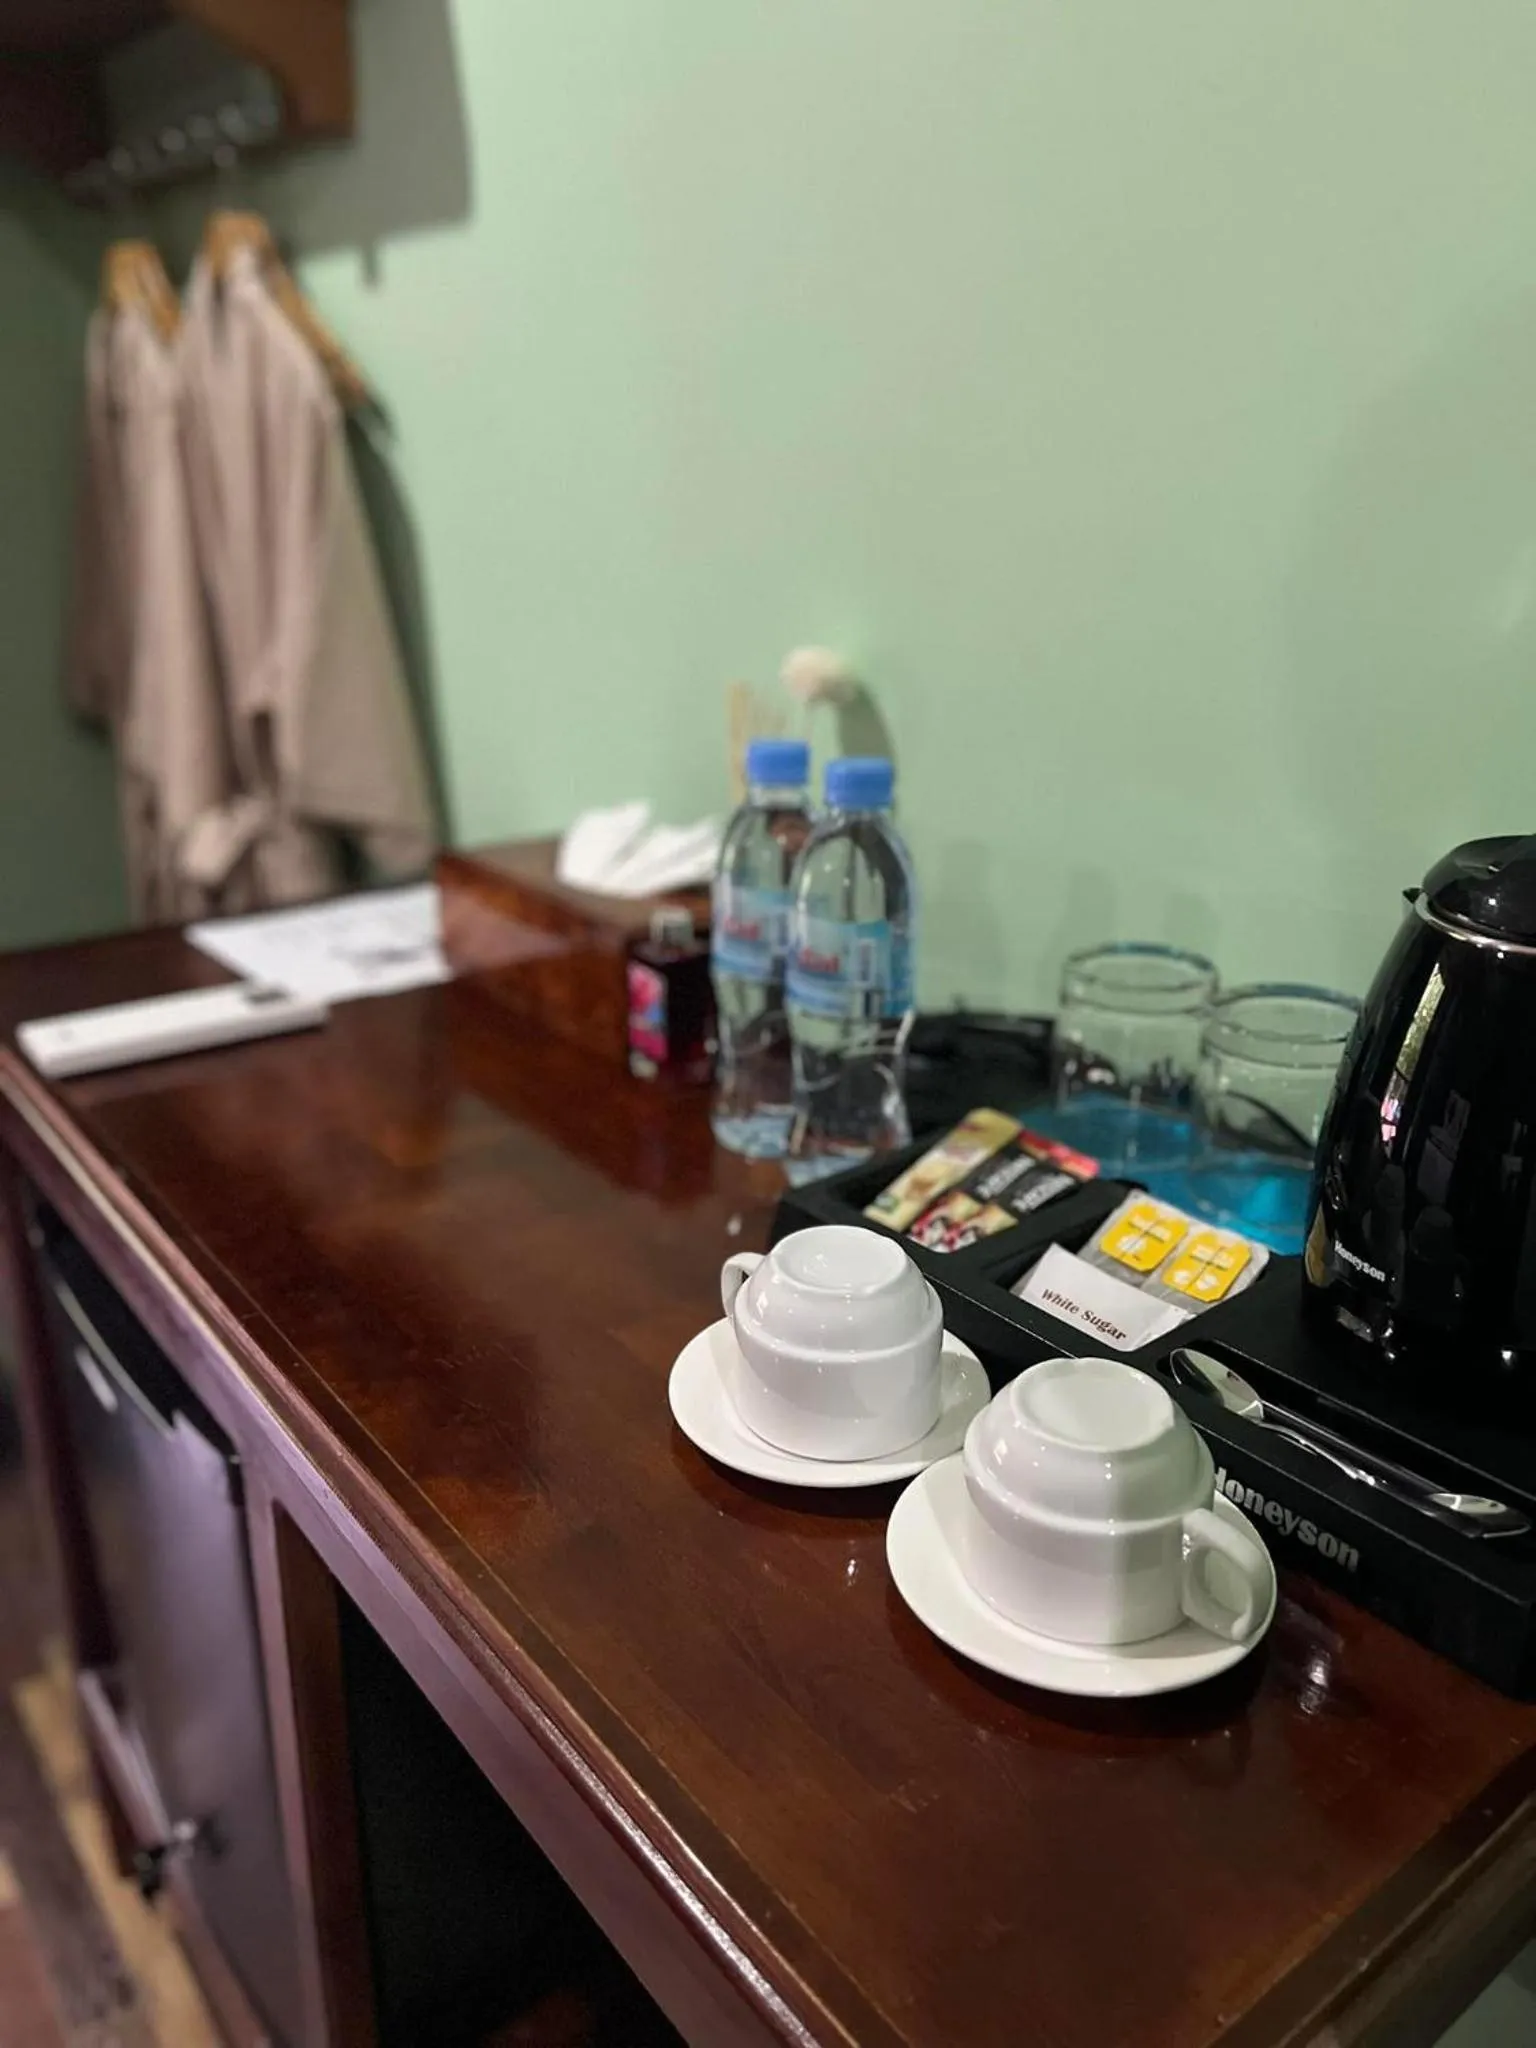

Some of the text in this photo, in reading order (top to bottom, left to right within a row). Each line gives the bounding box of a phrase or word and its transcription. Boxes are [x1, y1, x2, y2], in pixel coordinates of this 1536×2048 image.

[1334, 1239, 1386, 1282] Honeyson
[1041, 1288, 1126, 1340] White Sugar
